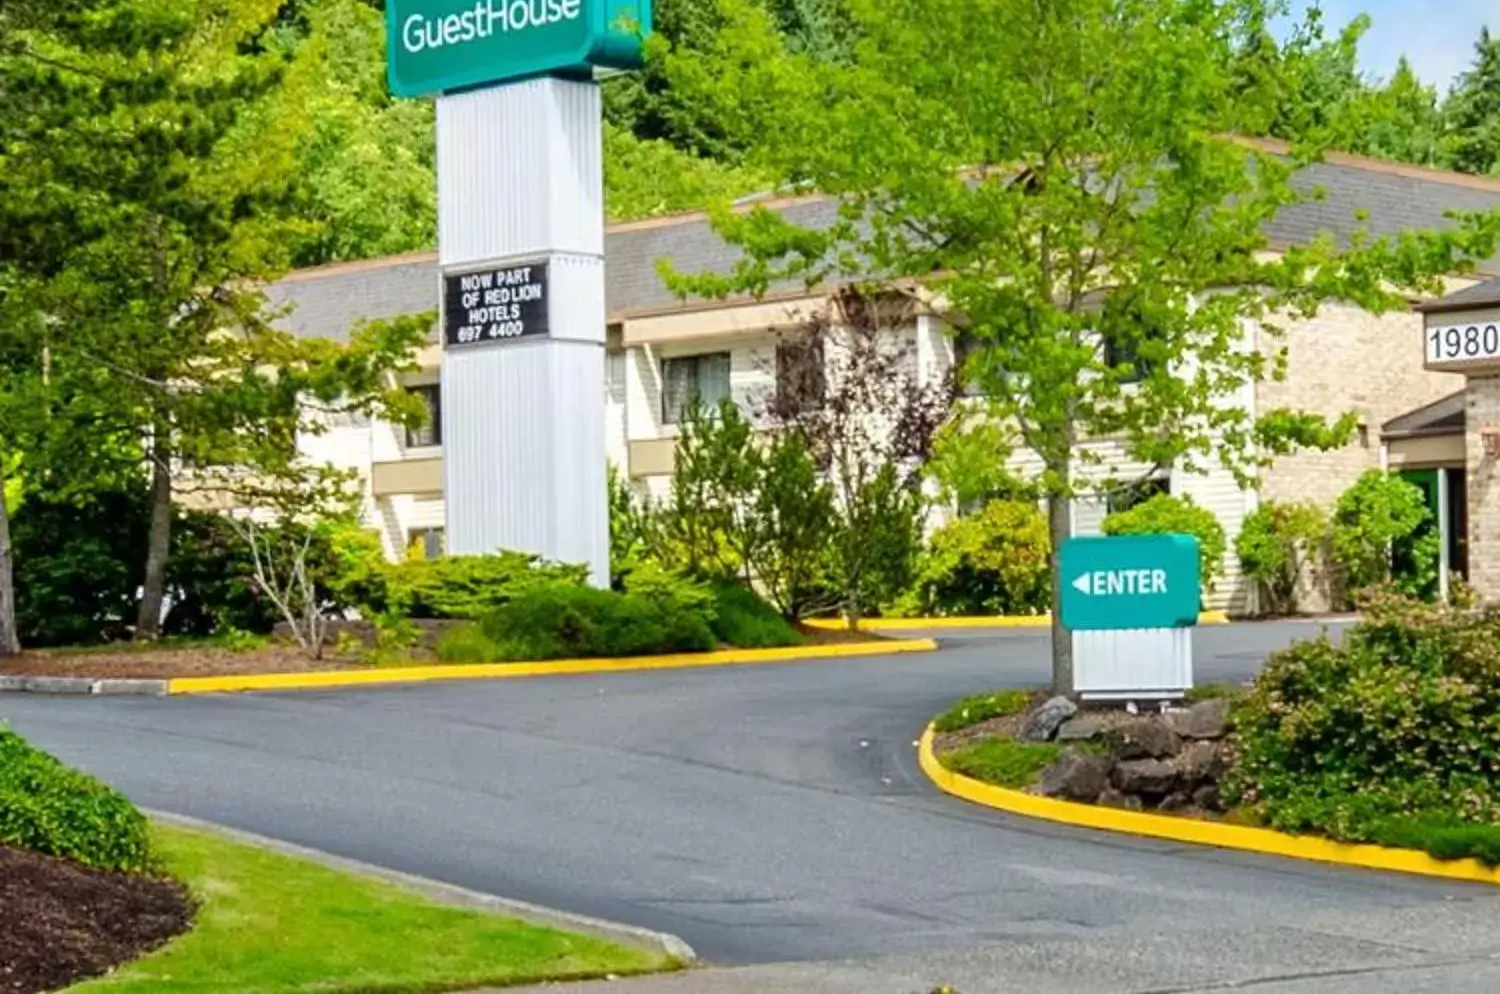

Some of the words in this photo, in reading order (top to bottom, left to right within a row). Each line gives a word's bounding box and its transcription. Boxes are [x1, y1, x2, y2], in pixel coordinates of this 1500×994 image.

[461, 274, 492, 291] NOW
[497, 268, 531, 286] PART
[462, 292, 480, 309] OF
[485, 288, 510, 305] RED
[512, 284, 541, 301] LION
[468, 304, 520, 324] HOTELS
[489, 320, 523, 337] 4400
[1093, 569, 1168, 595] ENTER
